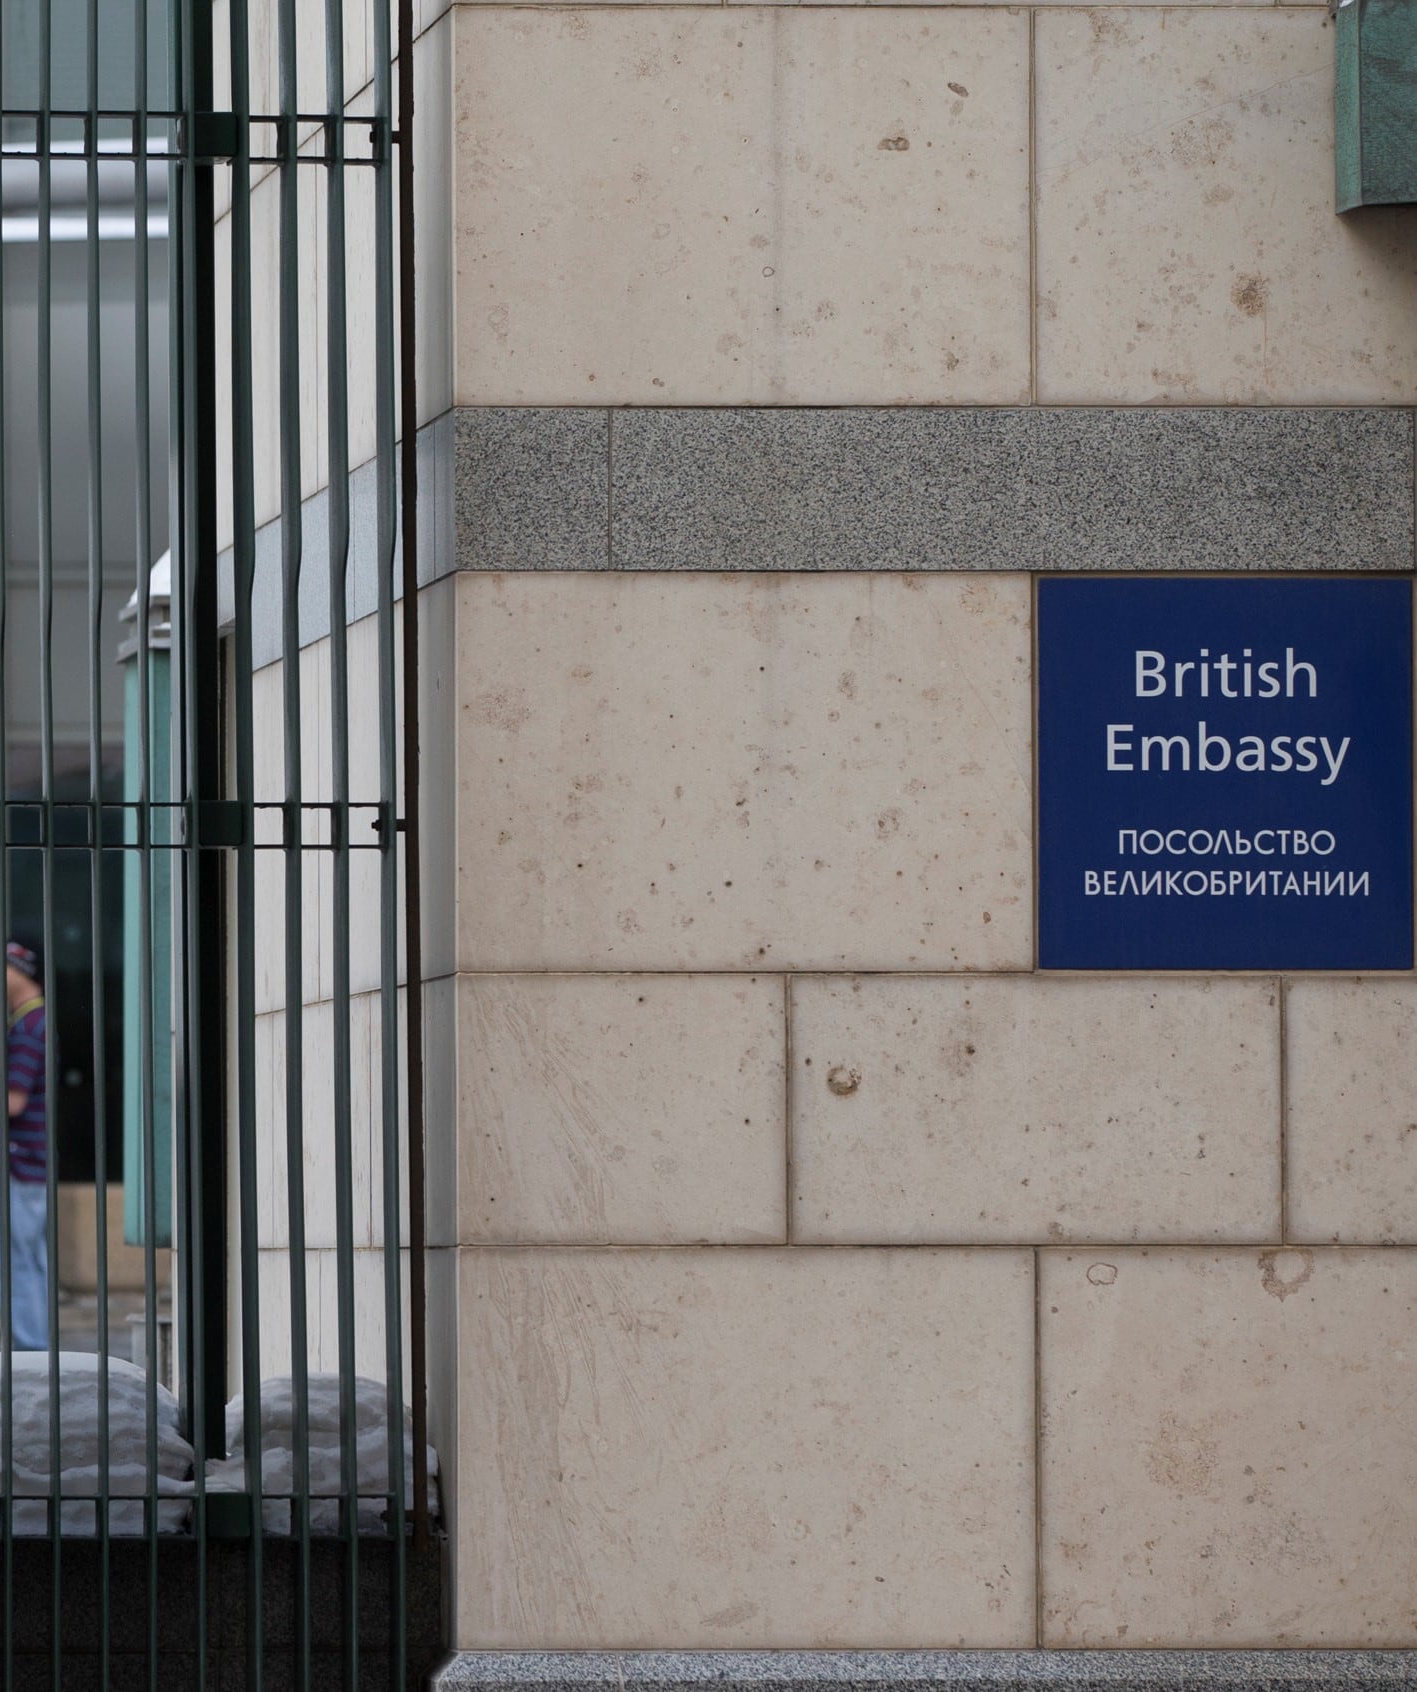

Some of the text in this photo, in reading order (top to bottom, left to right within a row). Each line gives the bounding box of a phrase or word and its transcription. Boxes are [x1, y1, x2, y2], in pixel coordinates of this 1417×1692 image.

[1134, 647, 1318, 698] British
[1106, 721, 1351, 786] Embassy
[1118, 829, 1336, 856] ПОСОЛЬСТВО
[1084, 870, 1370, 897] ВЕЛИКОБРИТАНИИ
